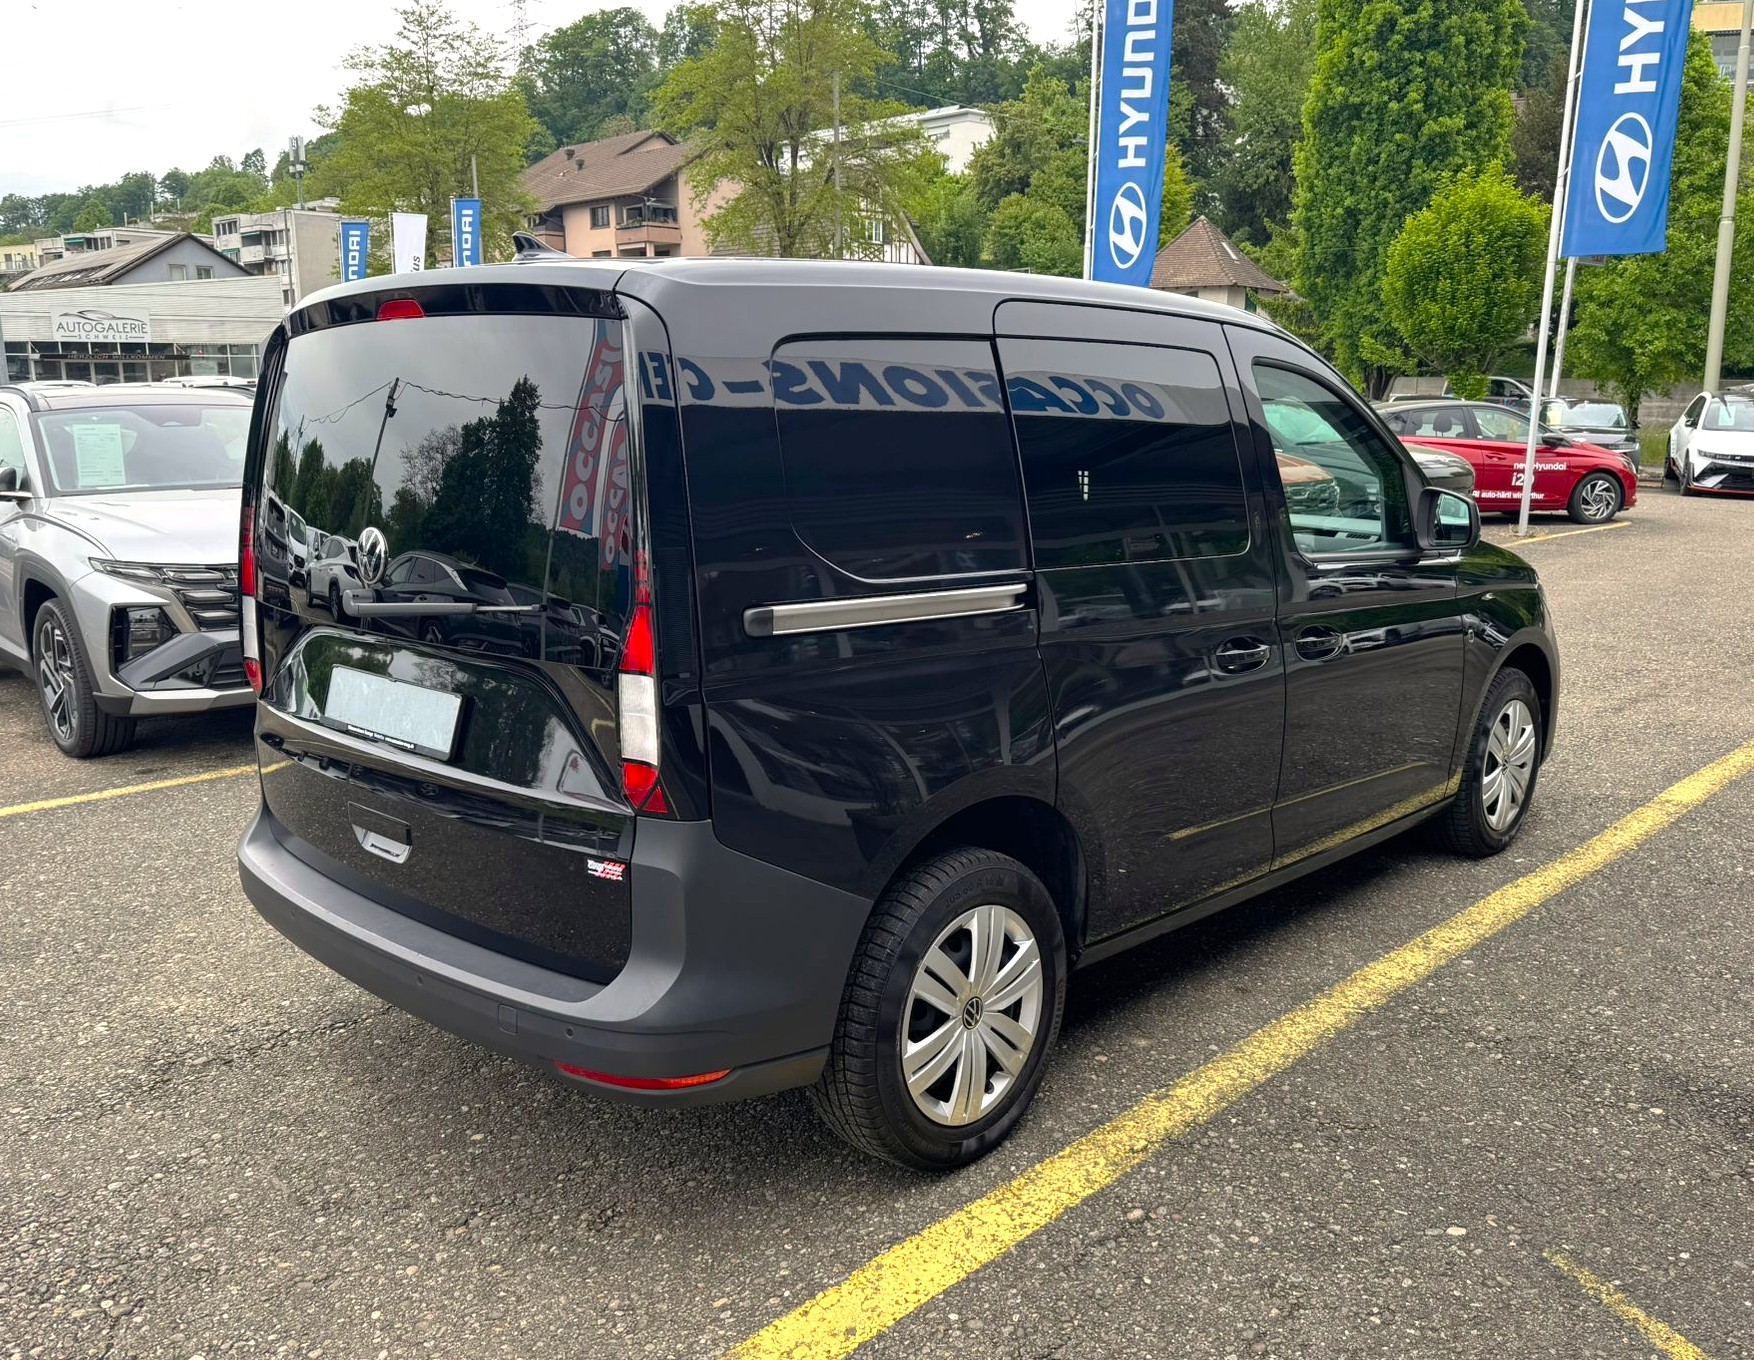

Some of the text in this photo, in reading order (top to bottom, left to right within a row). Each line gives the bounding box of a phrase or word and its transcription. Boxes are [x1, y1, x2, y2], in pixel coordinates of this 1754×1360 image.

[1613, 0, 1665, 94] HY
[410, 255, 421, 273] us
[56, 321, 148, 334] AUTOGALERIE
[77, 333, 129, 341] SCHWEIZ
[1511, 472, 1535, 486] i2
